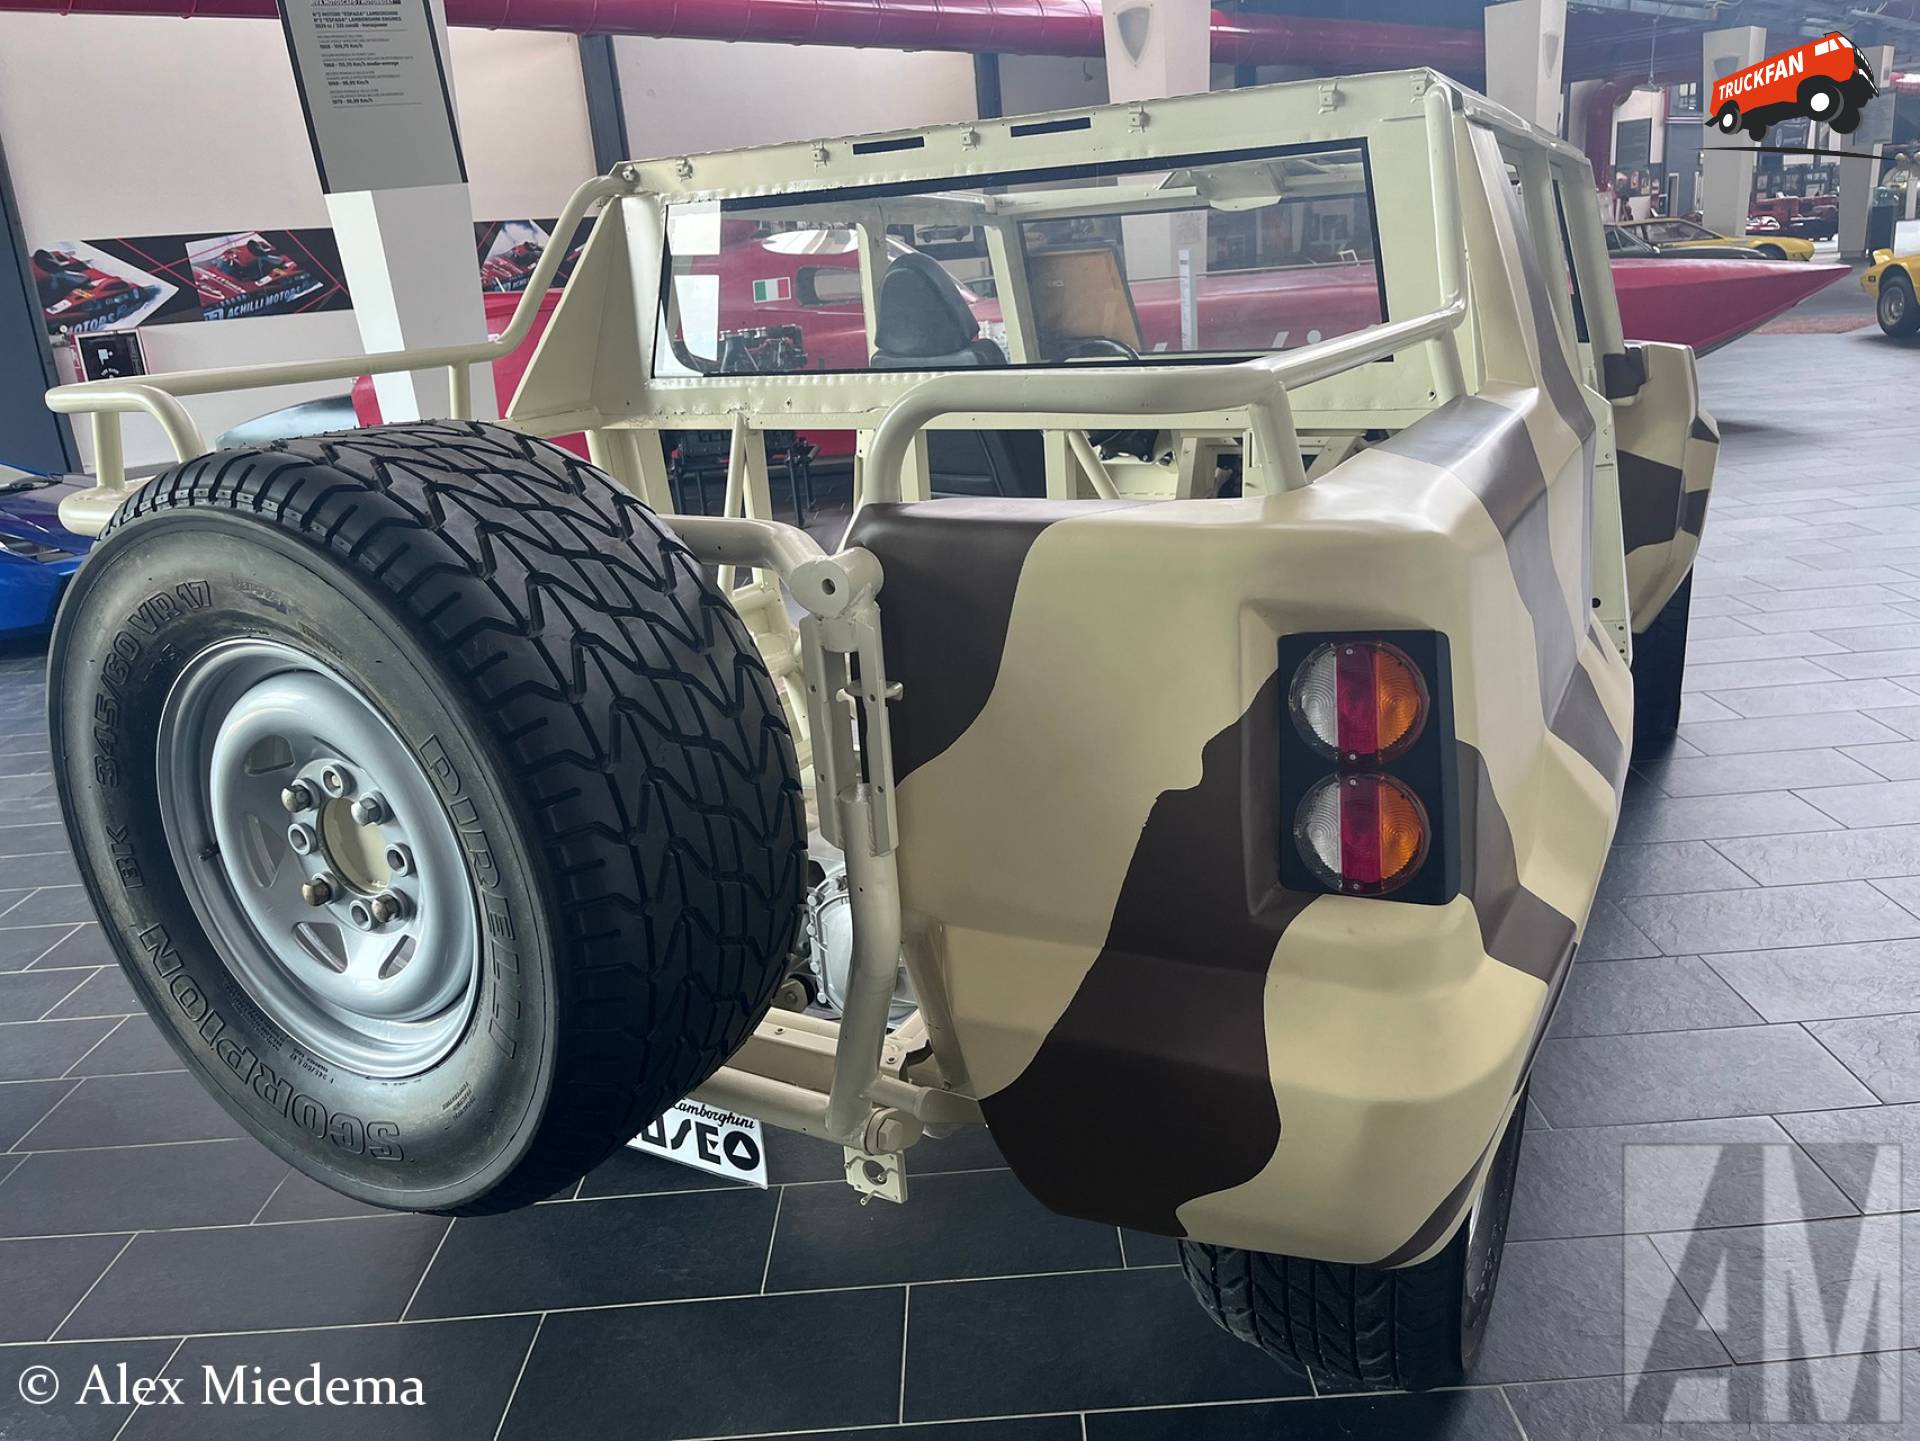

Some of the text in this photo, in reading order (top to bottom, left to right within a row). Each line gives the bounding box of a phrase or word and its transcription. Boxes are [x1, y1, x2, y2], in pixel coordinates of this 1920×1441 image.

[128, 591, 181, 635] VR
[175, 580, 212, 610] 17
[419, 734, 518, 1060] PIRELLI
[139, 922, 405, 1162] SCORPION
